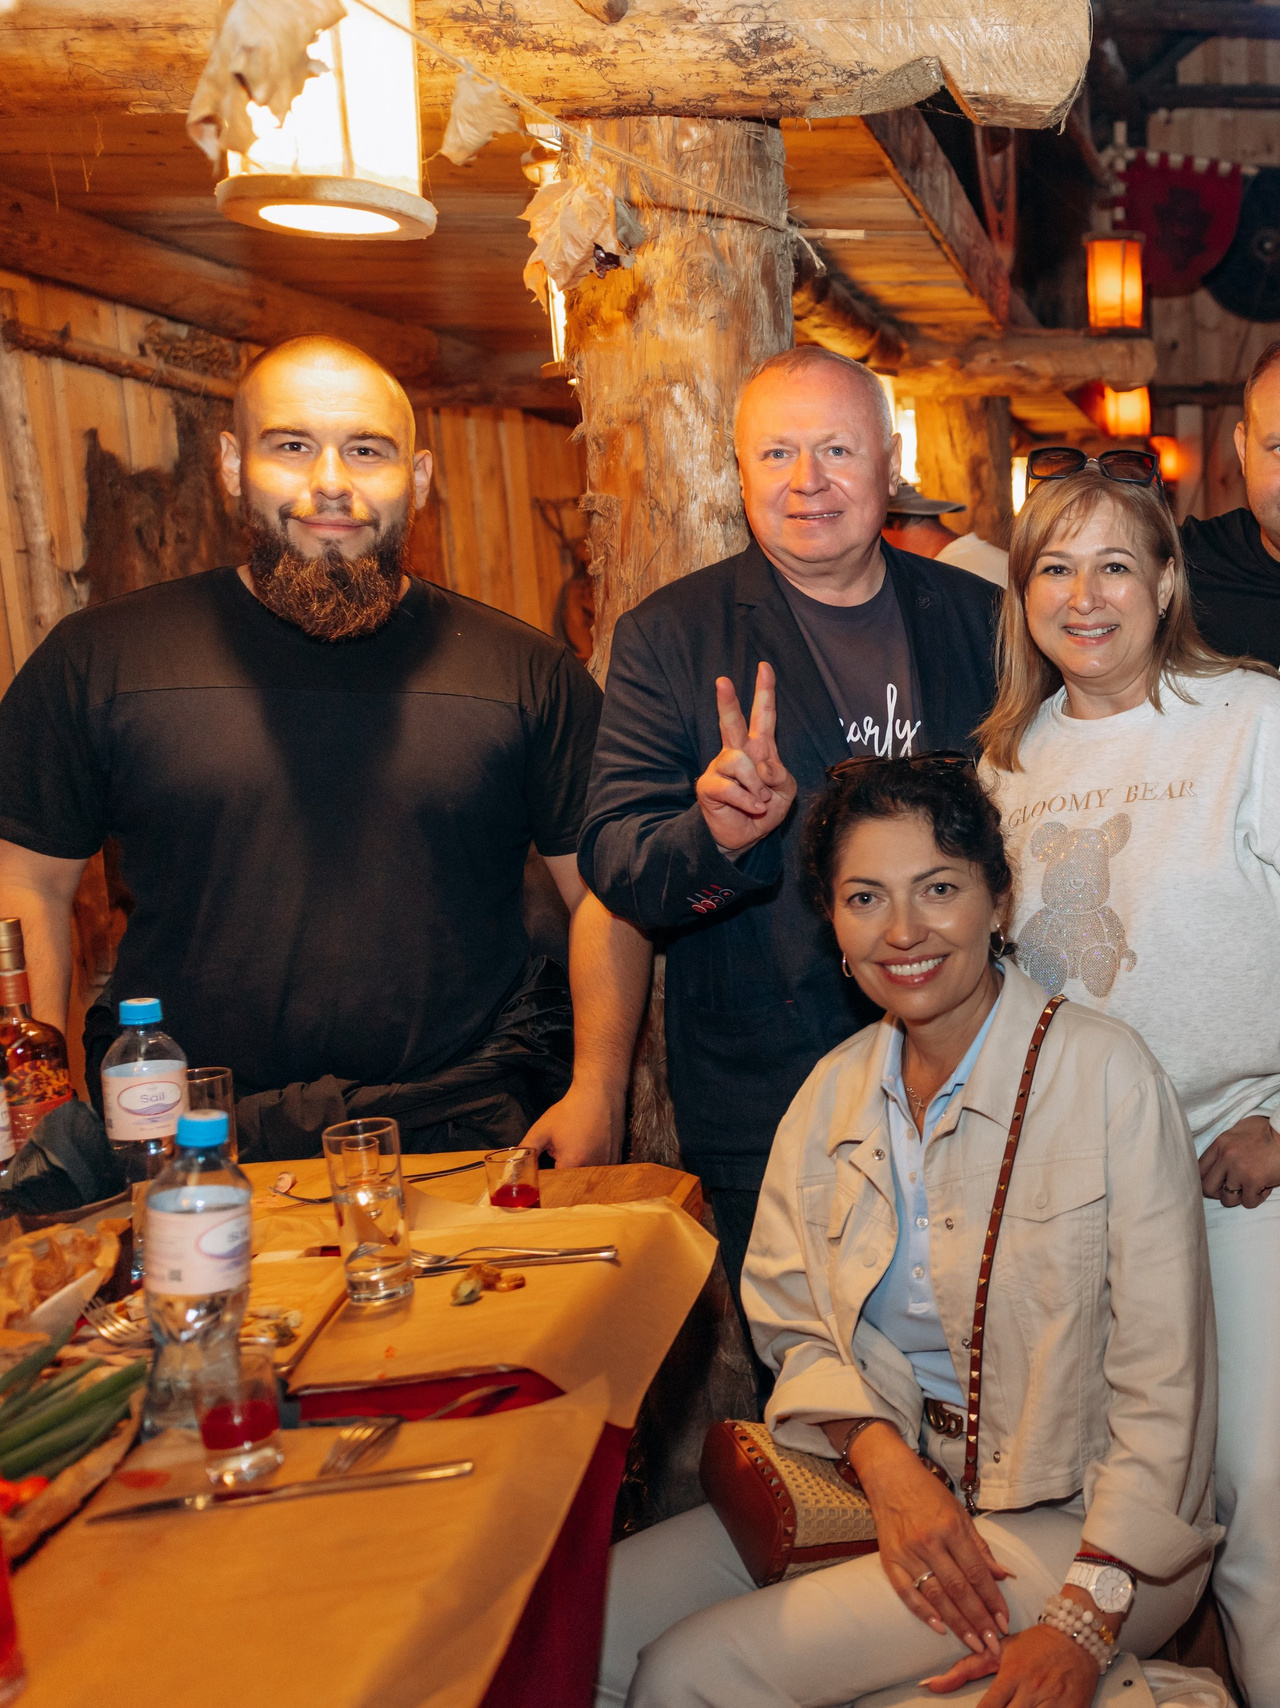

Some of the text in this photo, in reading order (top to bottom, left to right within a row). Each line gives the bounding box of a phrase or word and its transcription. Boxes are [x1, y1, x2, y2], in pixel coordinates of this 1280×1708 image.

[839, 683, 921, 760] arly
[1007, 779, 1197, 829] GLOOMY BEAR
[140, 1092, 165, 1103] Sail
